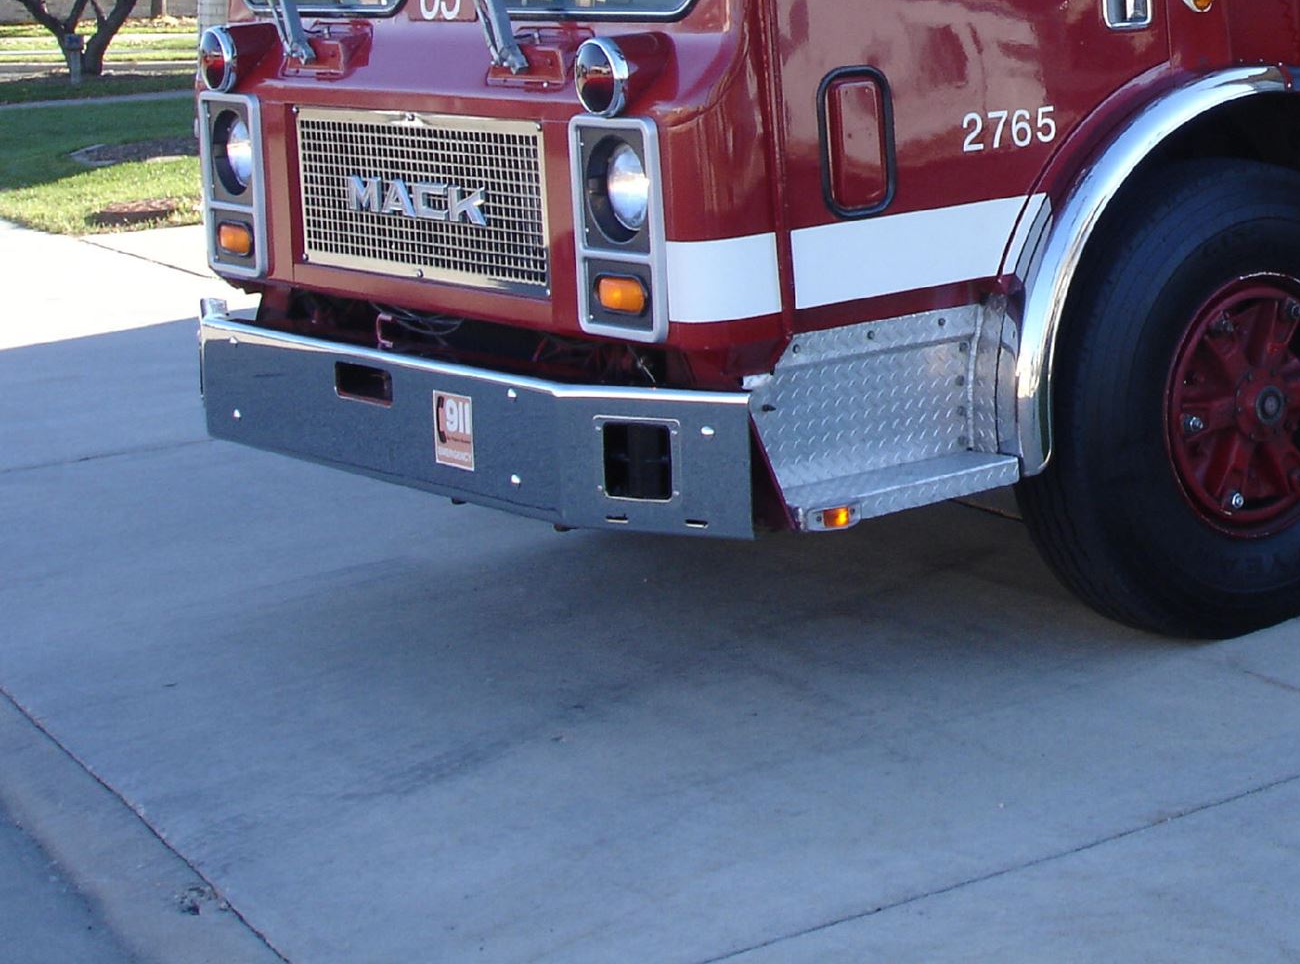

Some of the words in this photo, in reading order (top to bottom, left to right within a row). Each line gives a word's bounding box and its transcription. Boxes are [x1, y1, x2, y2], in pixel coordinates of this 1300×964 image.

[962, 105, 1057, 152] 2765
[346, 174, 487, 227] MACK
[445, 398, 471, 435] 911
